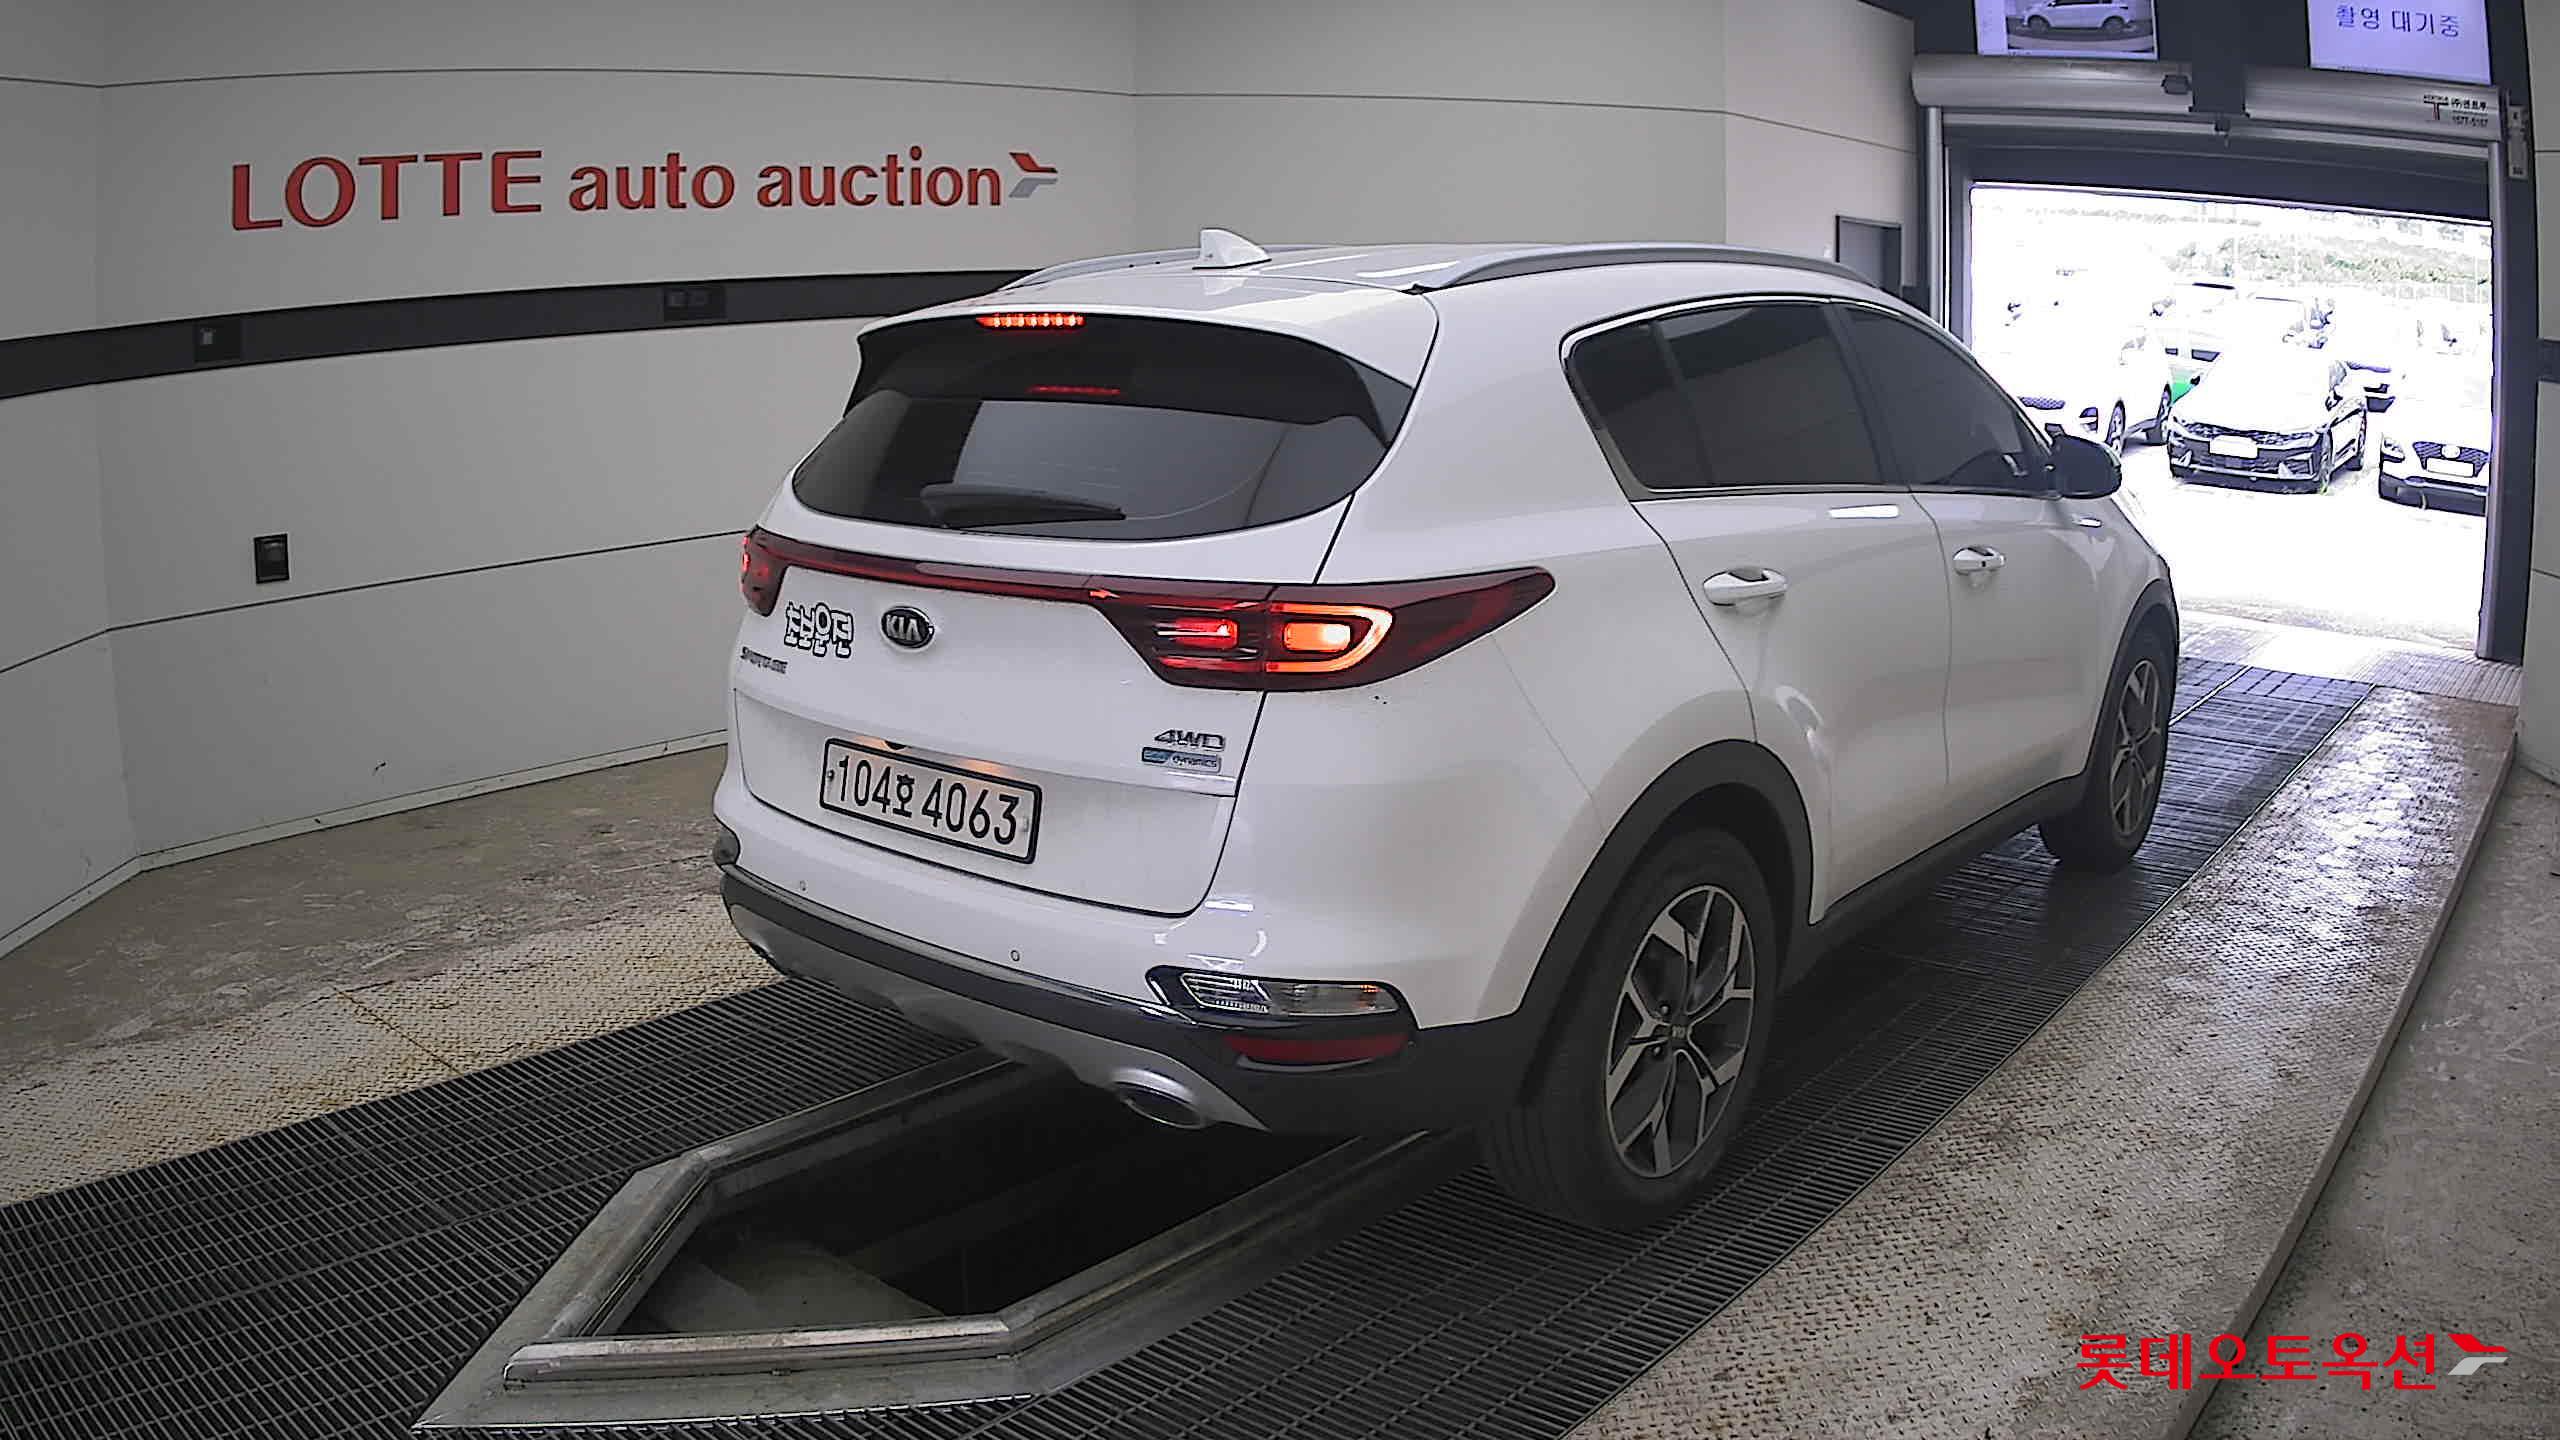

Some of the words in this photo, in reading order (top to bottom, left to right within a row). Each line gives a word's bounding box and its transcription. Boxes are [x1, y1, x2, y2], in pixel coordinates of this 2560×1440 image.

[2336, 4, 2380, 30] 촬영
[232, 150, 543, 231] LOTTE
[568, 151, 736, 212] auto
[756, 145, 1001, 207] auction
[884, 612, 924, 643] KIA
[1153, 729, 1226, 751] 4WD
